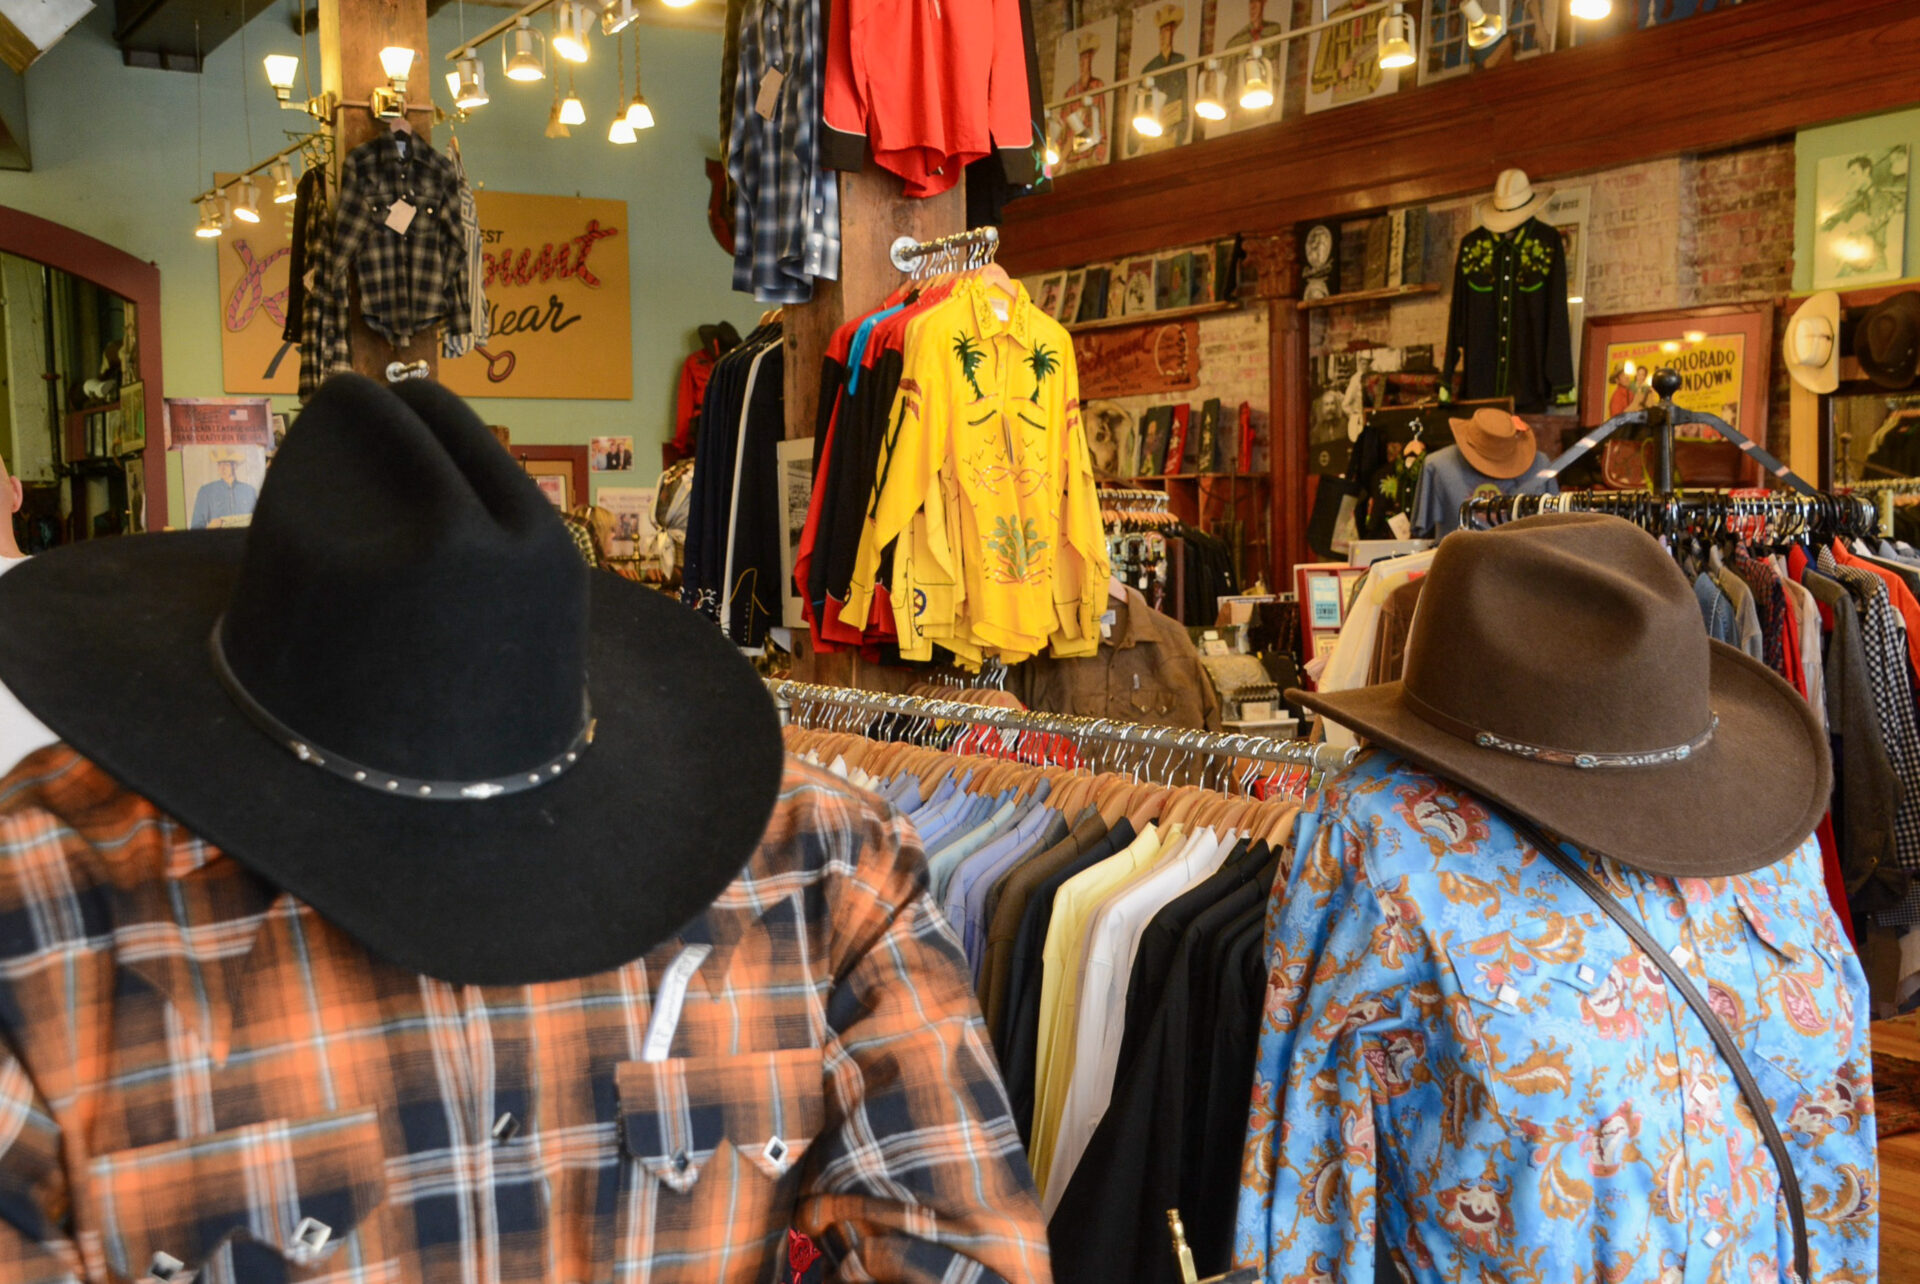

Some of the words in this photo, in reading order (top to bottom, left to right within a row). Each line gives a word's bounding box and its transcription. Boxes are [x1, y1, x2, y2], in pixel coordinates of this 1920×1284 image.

[480, 229, 504, 244] EST
[1665, 350, 1736, 373] COLORADO
[1678, 368, 1733, 391] NDOWN
